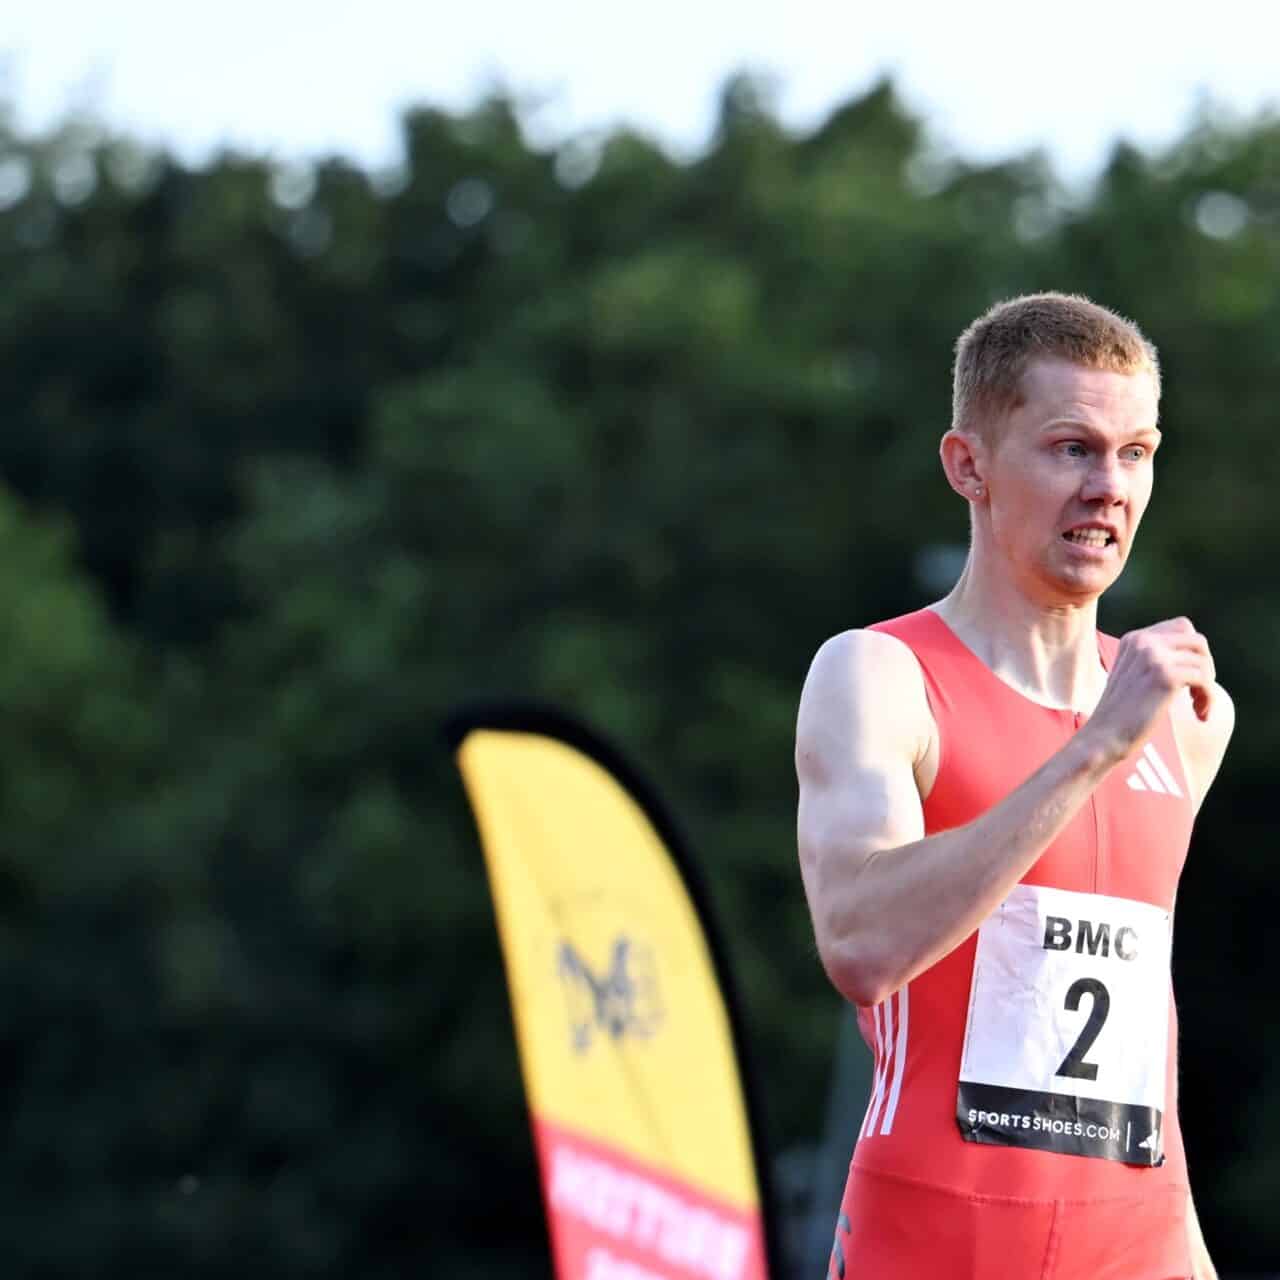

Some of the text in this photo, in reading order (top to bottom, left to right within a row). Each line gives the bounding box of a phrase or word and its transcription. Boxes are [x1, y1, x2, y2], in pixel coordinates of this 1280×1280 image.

[1043, 916, 1139, 961] BMC
[1054, 977, 1111, 1081] 2
[968, 1109, 1120, 1141] SPORTSSHOES.COM
